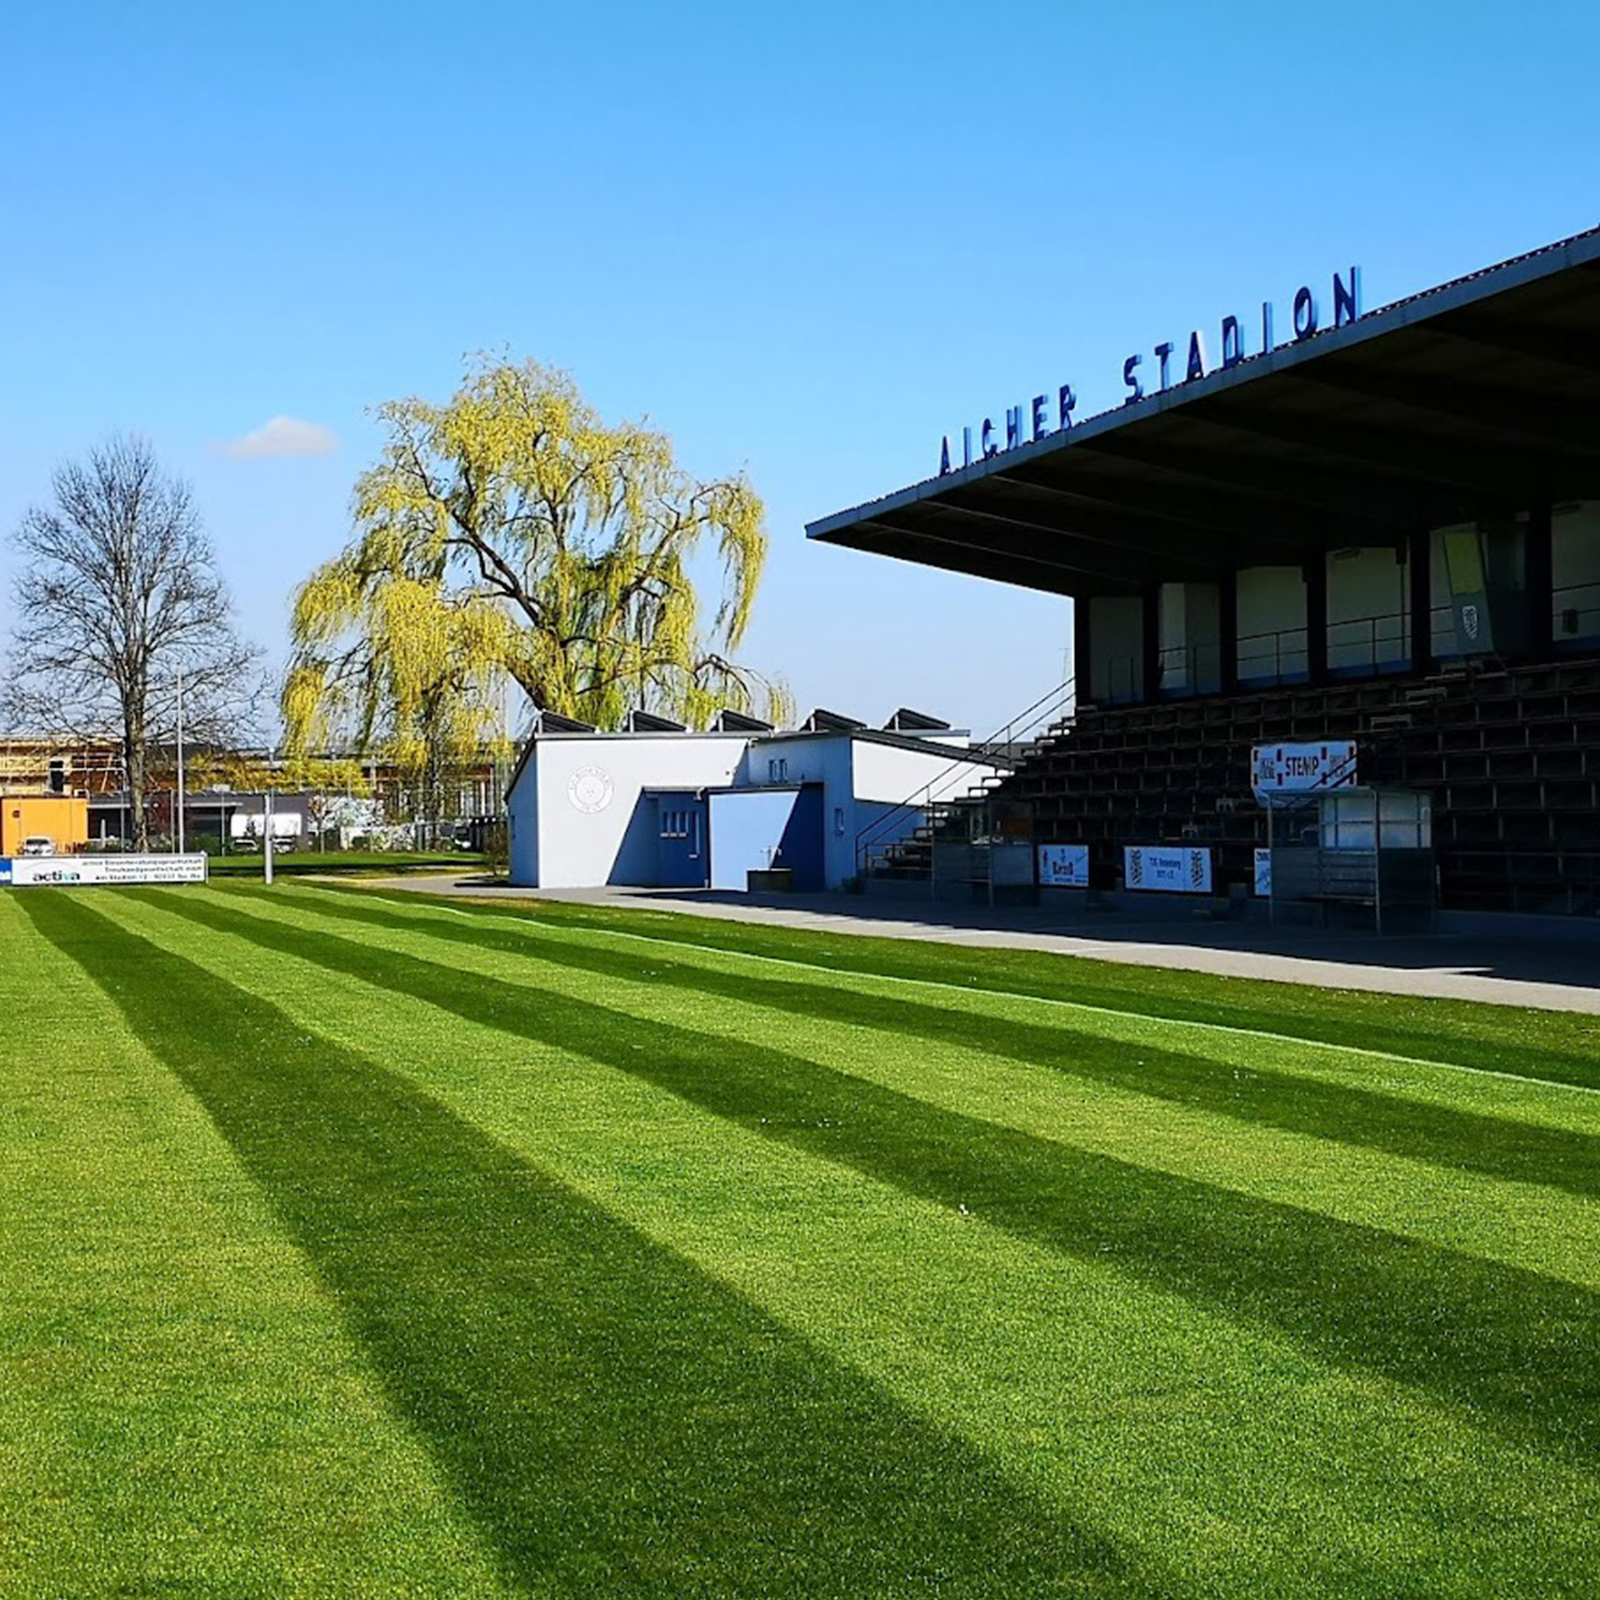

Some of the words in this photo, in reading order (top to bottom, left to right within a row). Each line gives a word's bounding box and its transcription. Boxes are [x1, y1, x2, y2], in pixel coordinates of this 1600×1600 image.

[939, 383, 1076, 476] AICHER
[1123, 265, 1361, 405] STADION
[33, 869, 81, 882] activa
